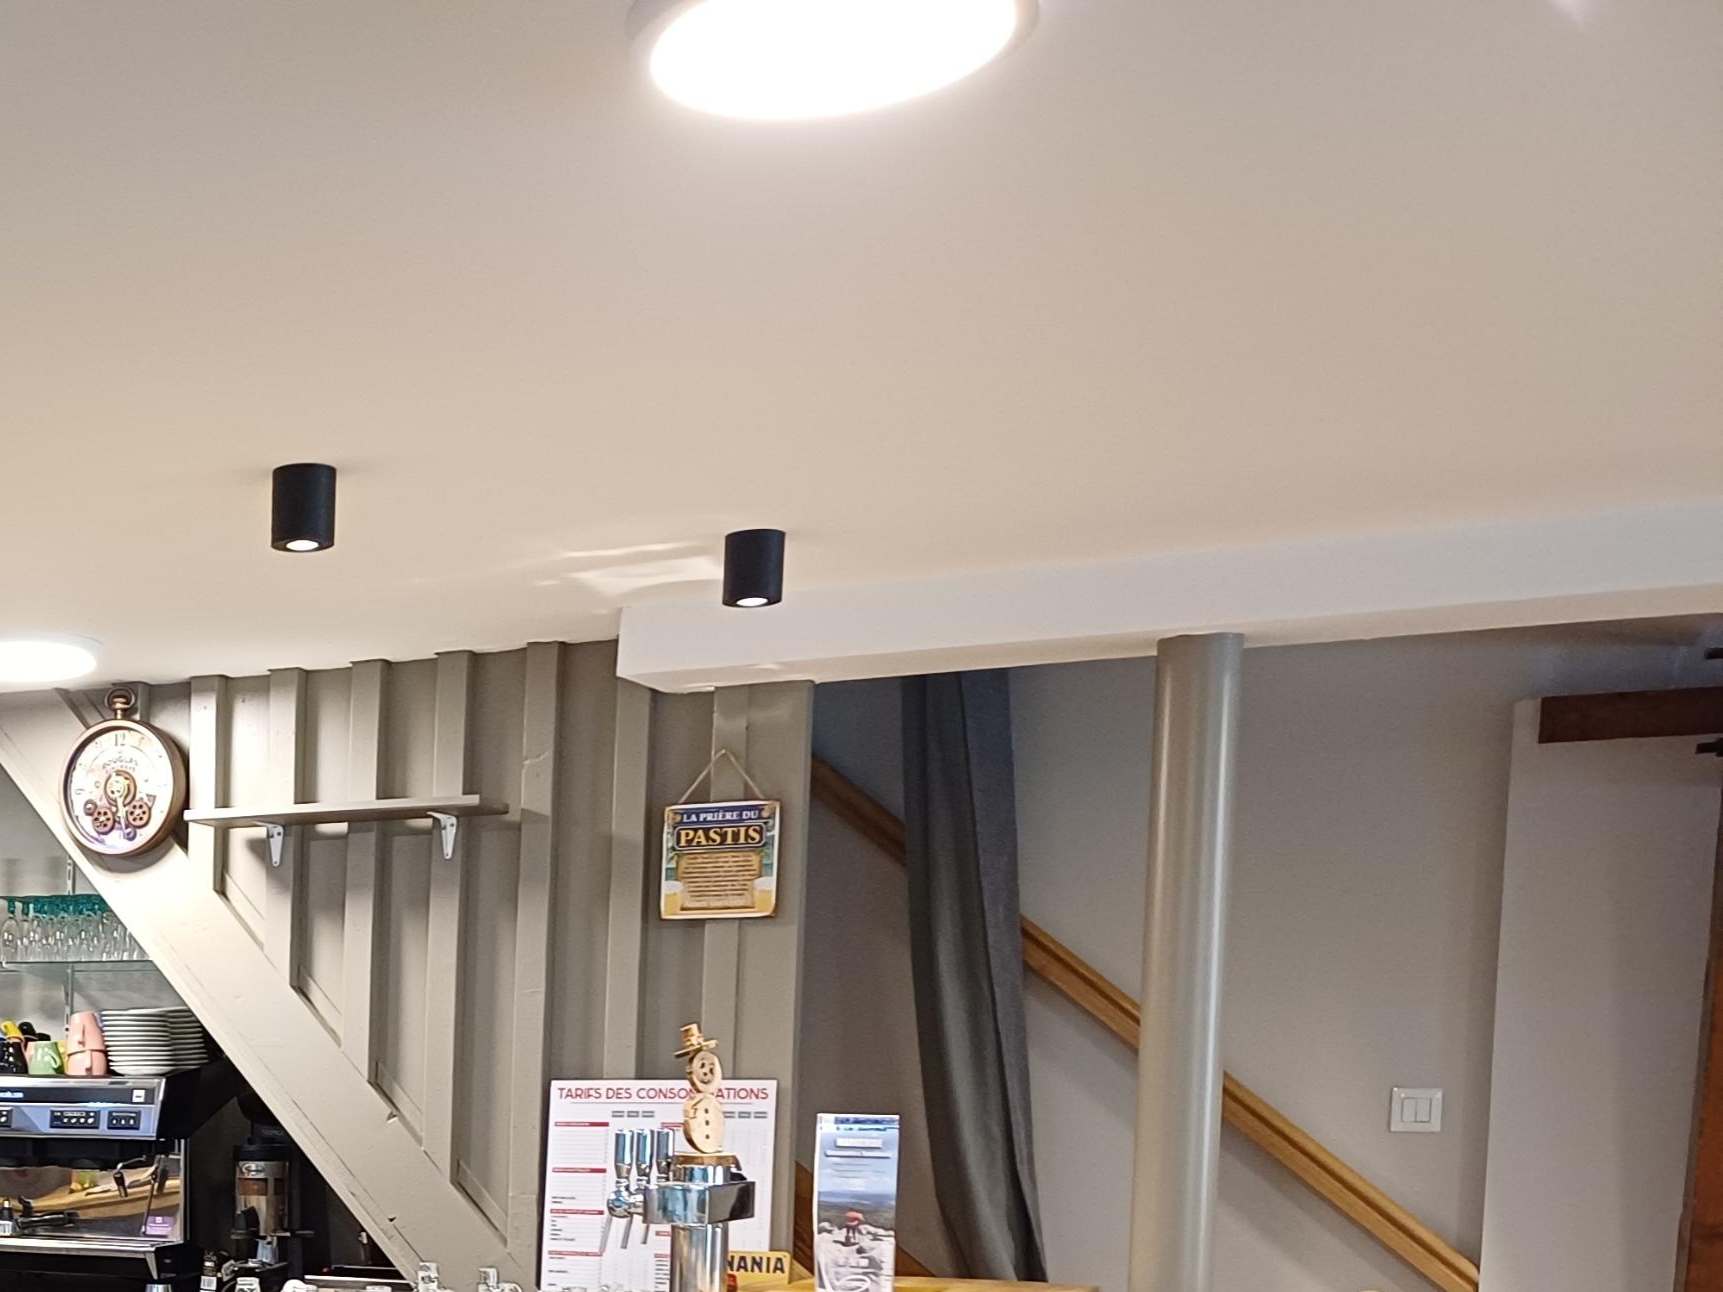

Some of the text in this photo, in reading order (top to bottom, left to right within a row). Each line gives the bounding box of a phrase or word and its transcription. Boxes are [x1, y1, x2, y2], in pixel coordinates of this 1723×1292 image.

[682, 810, 759, 822] LA PRIÈRE DU
[678, 825, 761, 847] PASTIS
[557, 1087, 769, 1100] TARIFS DES CONSOATIONS
